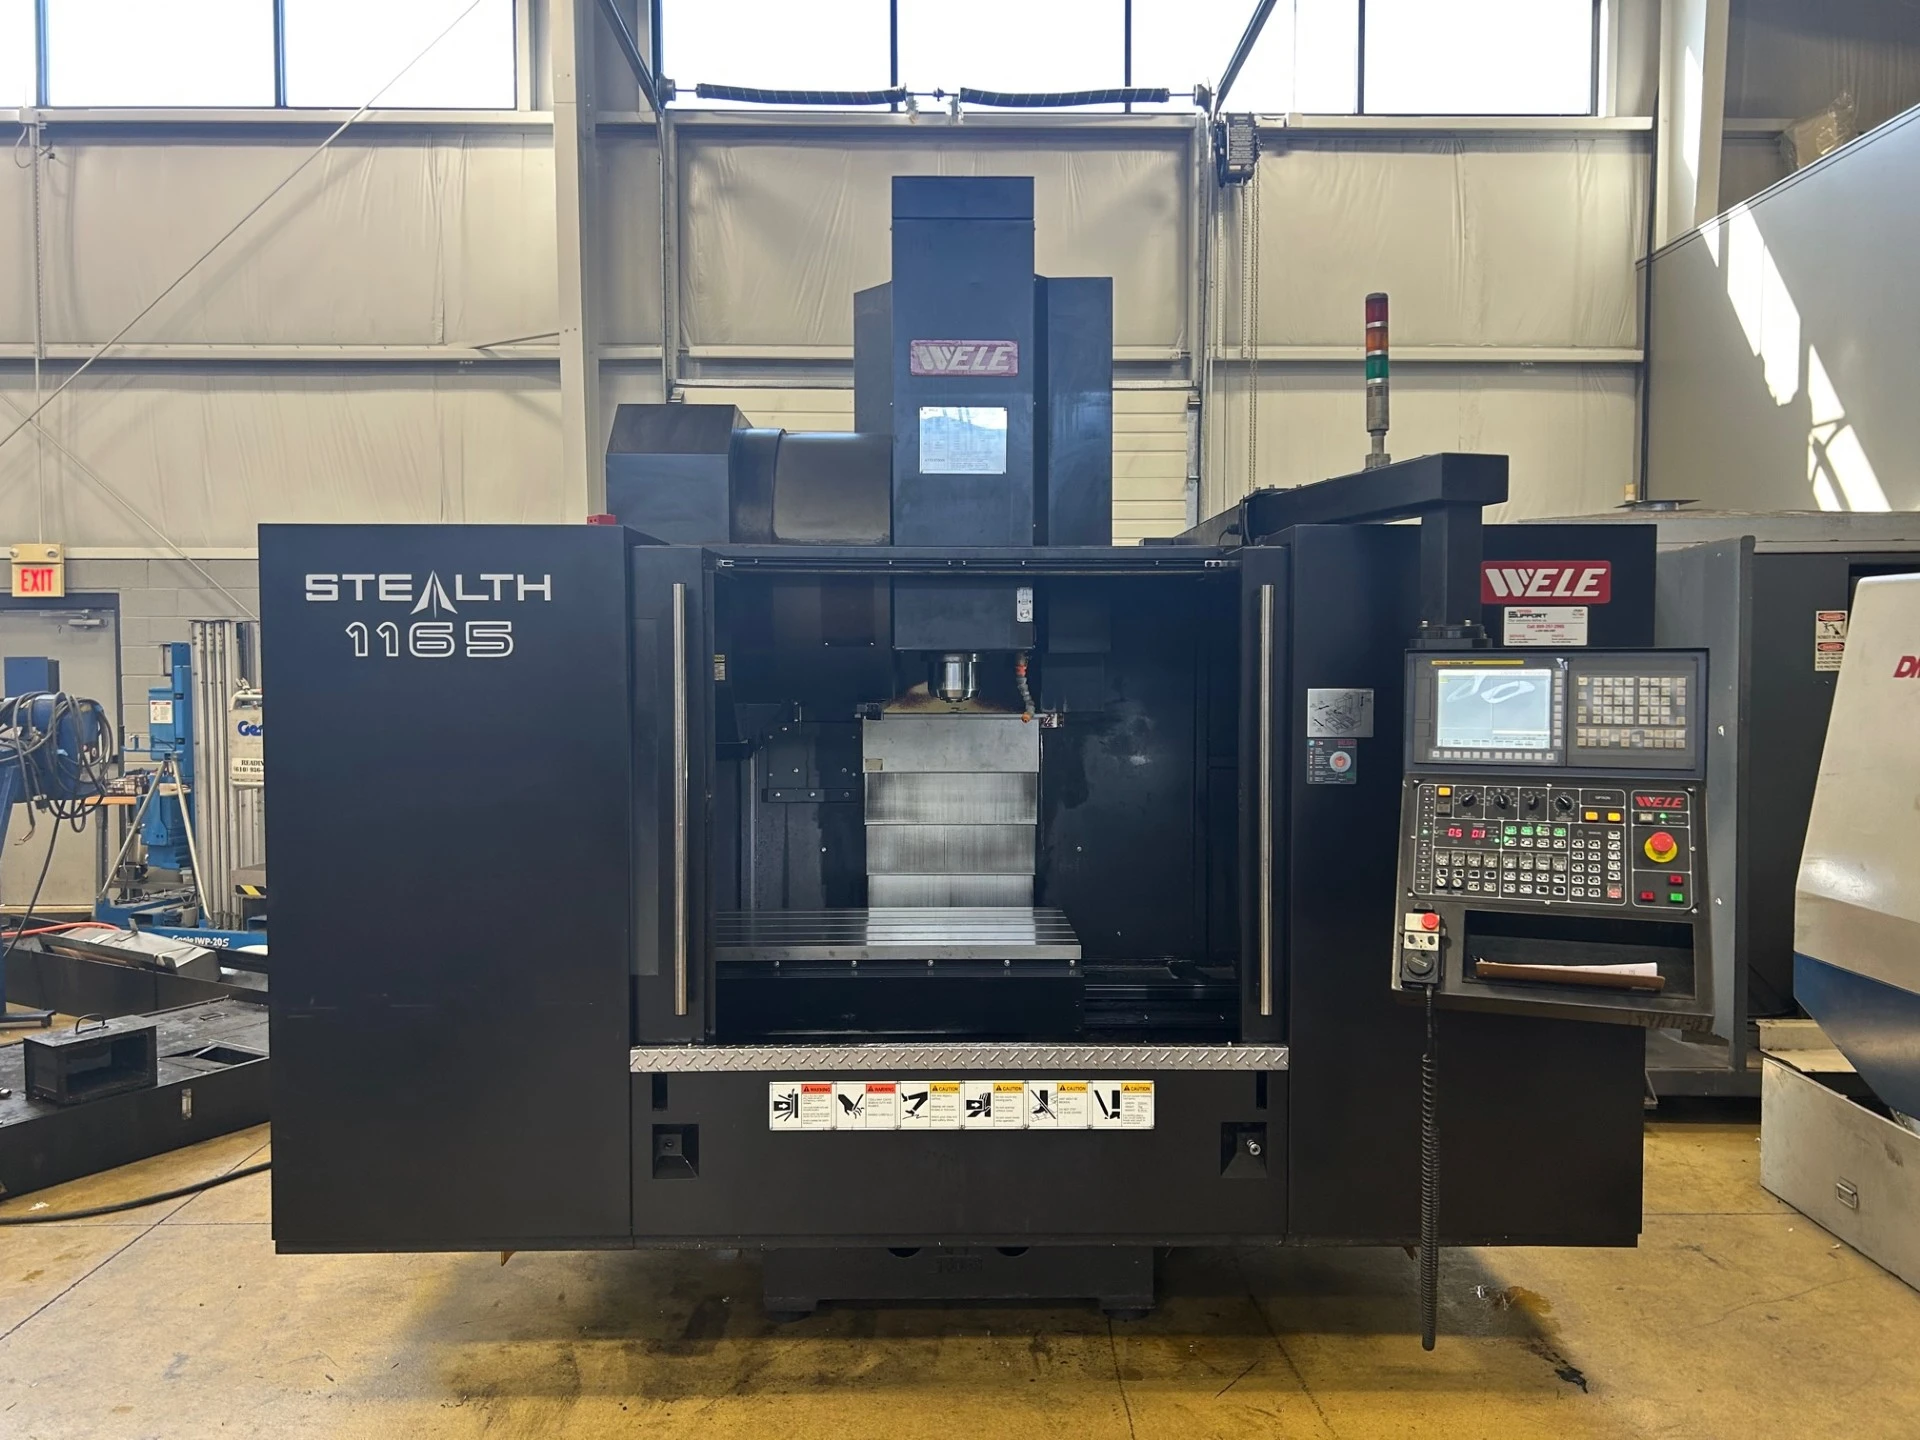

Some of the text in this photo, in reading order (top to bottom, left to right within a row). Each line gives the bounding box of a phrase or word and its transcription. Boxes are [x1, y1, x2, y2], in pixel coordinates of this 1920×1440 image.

[913, 345, 1014, 371] WELE
[21, 568, 54, 592] EXIT
[305, 570, 551, 616] STEALTH
[1485, 568, 1607, 597] WELE
[345, 621, 514, 658] 1165
[1635, 796, 1685, 808] WELE
[1448, 828, 1486, 838] 05 01
